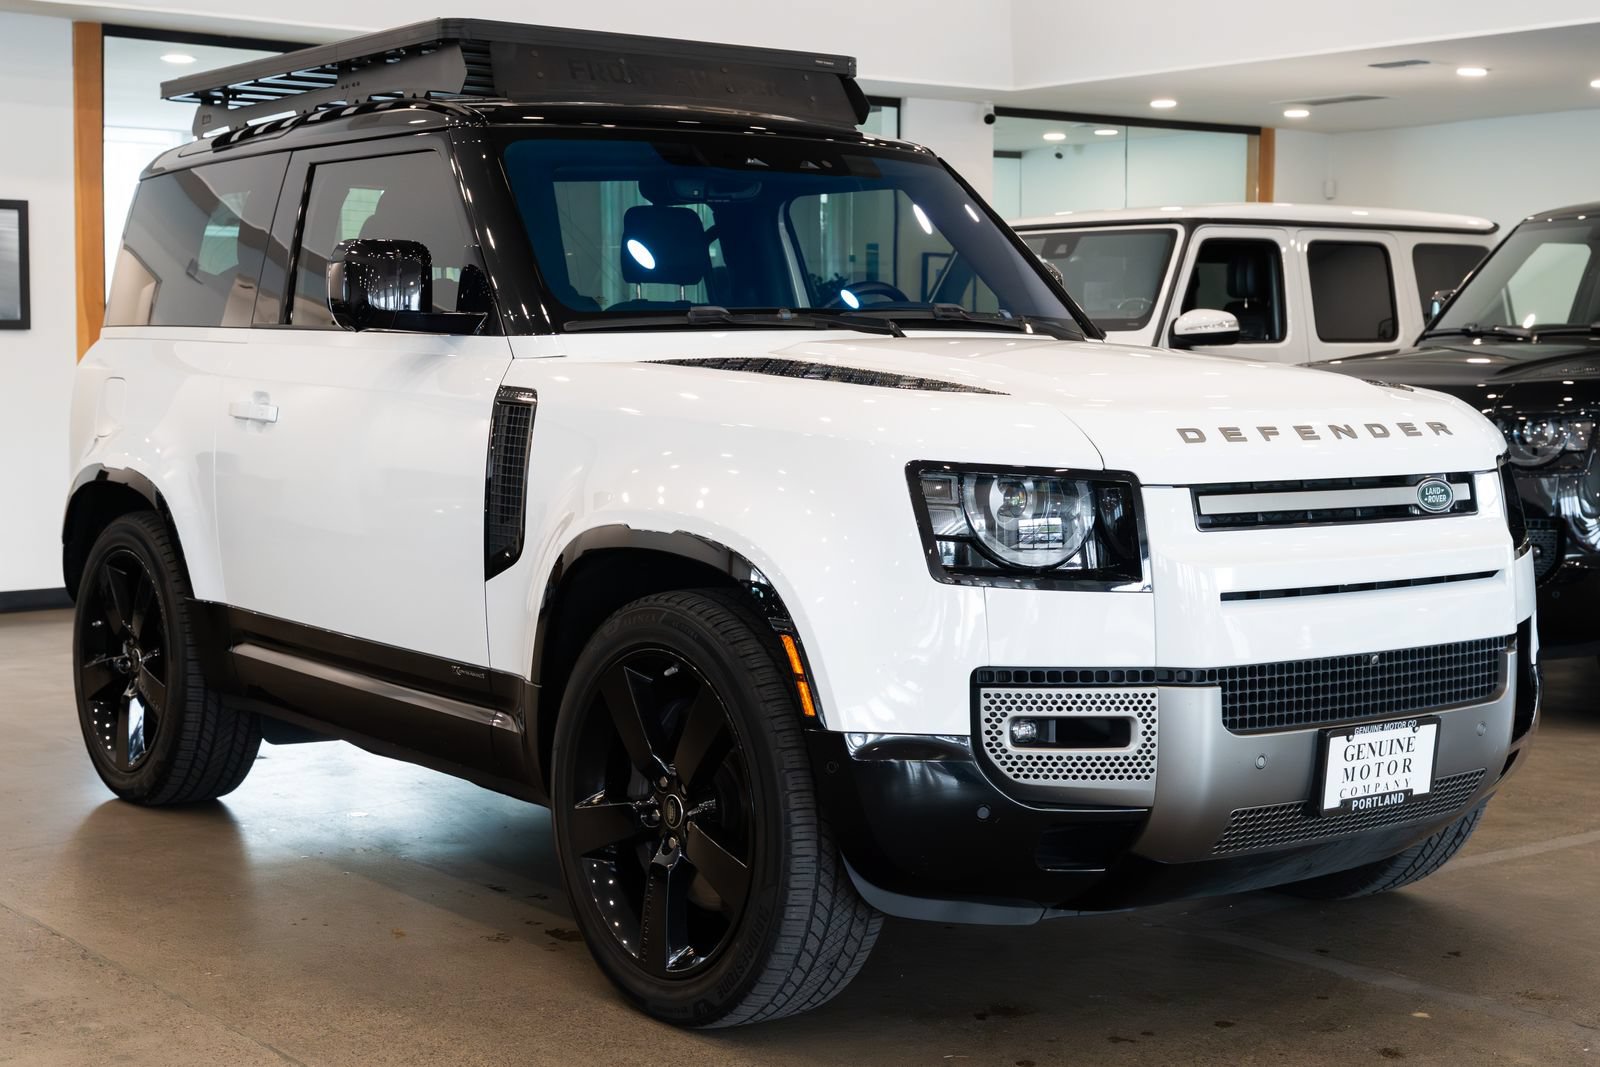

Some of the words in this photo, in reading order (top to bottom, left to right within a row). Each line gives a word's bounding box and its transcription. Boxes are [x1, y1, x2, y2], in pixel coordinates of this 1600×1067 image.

[1176, 421, 1453, 443] DEFENDER
[1425, 487, 1441, 495] LAND
[1427, 494, 1447, 503] ROVER
[1354, 724, 1383, 735] GENUINE
[1383, 721, 1407, 731] MOTOR
[1343, 736, 1416, 762] GENUINE
[1341, 758, 1412, 783] MOTOR
[1339, 778, 1412, 799] COMPANY
[1351, 792, 1405, 811] PORTLAND
